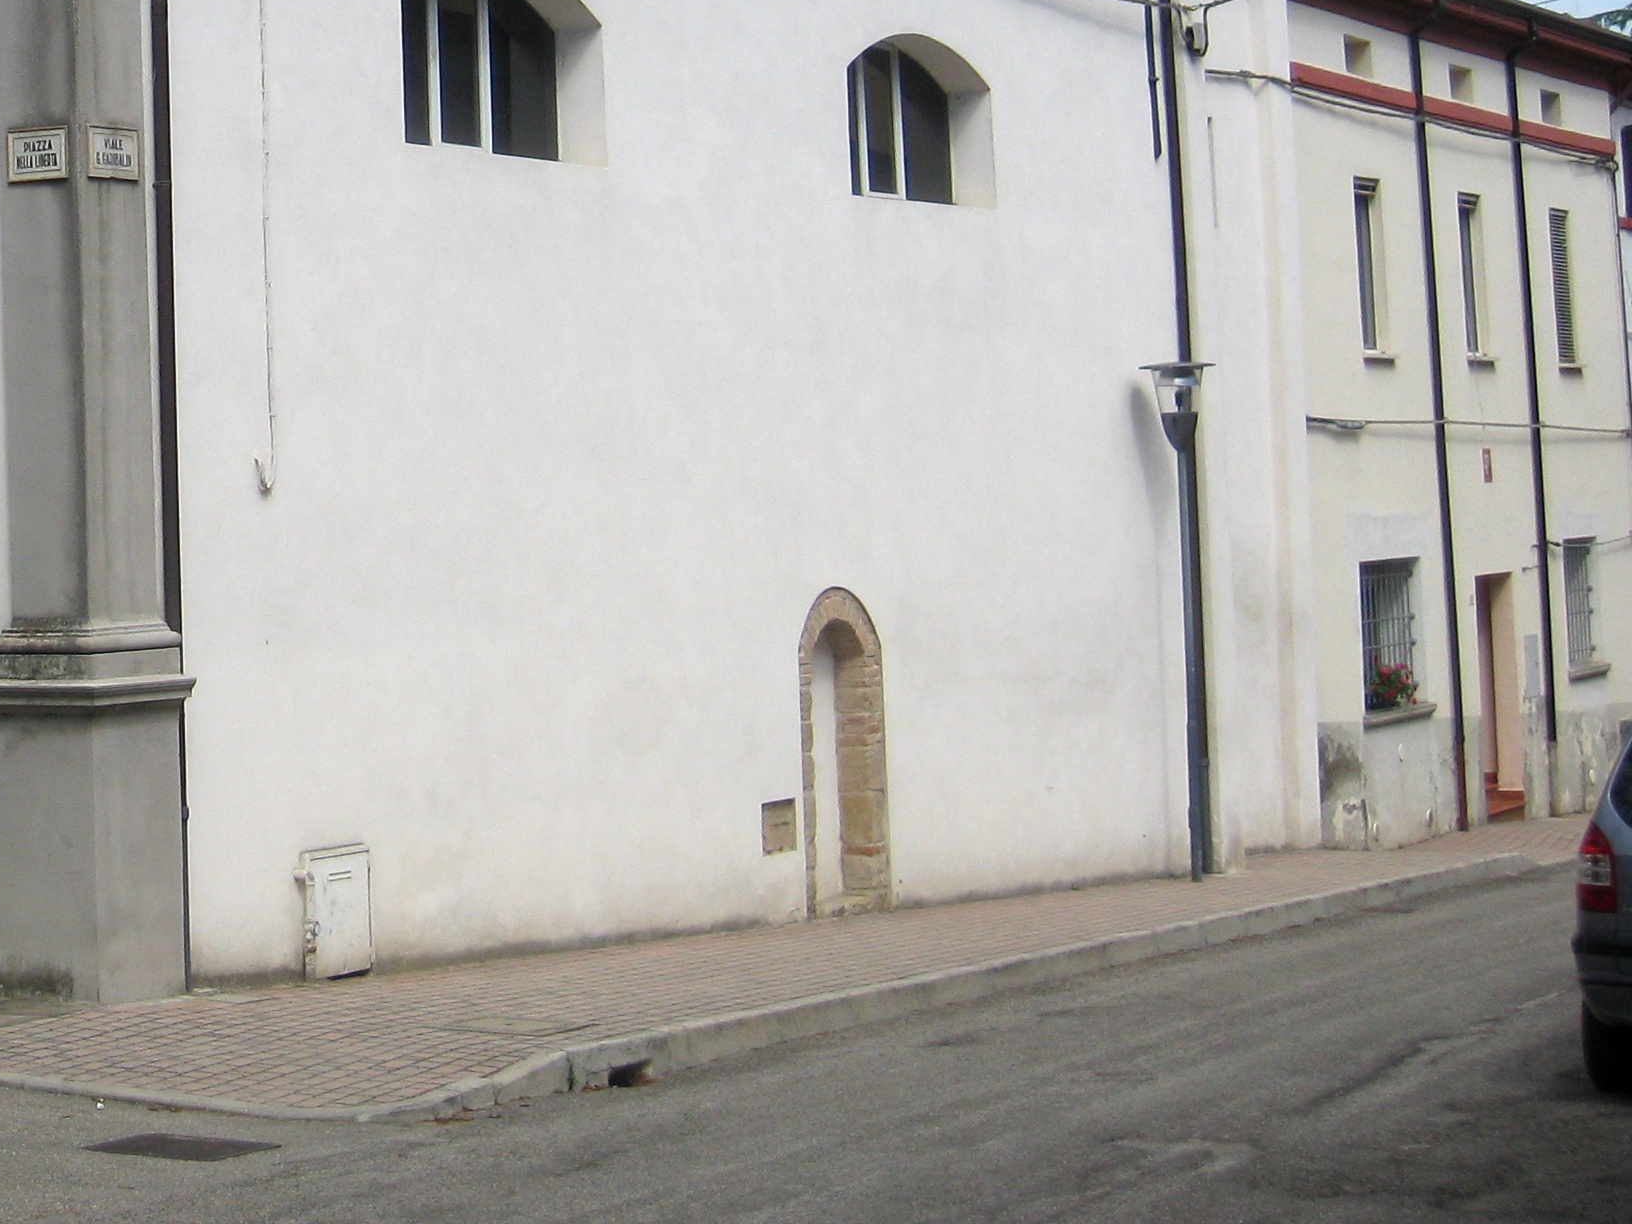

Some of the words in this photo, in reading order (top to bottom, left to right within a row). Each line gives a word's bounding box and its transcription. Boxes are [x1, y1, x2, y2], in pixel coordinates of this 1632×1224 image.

[23, 139, 53, 152] PIAZZA
[104, 138, 123, 151] VIALE
[16, 155, 33, 169] DELLA
